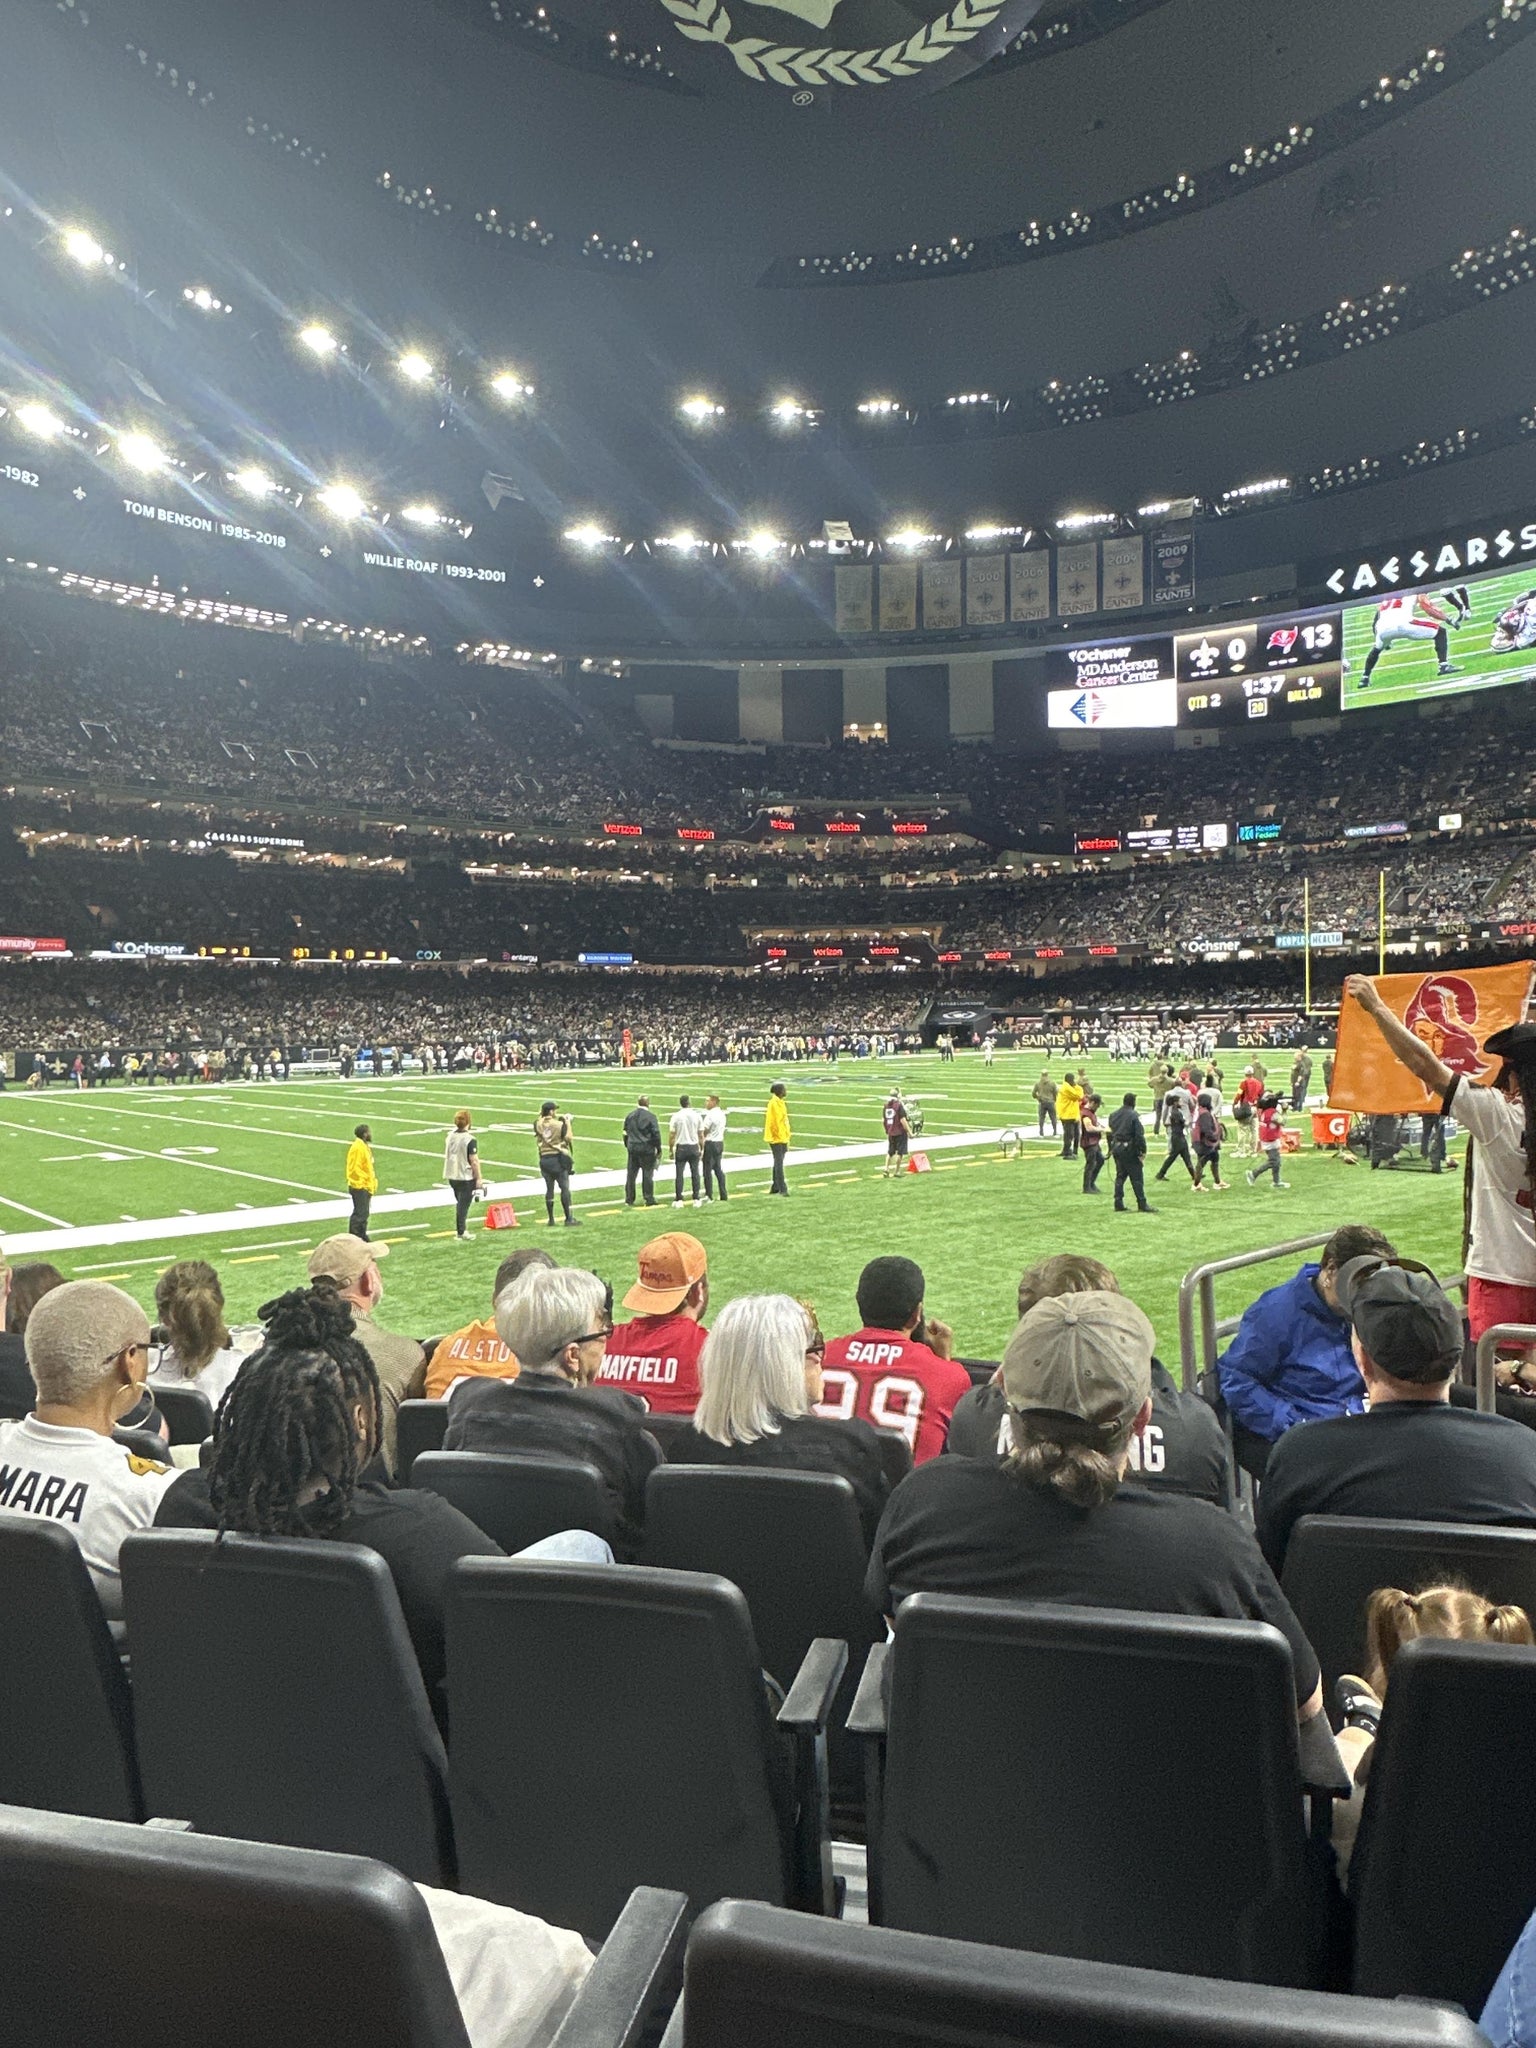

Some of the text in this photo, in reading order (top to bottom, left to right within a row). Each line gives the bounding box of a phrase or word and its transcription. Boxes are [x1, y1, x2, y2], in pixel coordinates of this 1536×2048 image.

[123, 499, 287, 548] TOM BENSON 1985-2018
[1158, 544, 1188, 558] 2009
[363, 552, 506, 582] WILLIE ROAF 1993-2001
[1326, 529, 1515, 594] CAESARS
[1154, 588, 1191, 601] SAINTS
[1301, 623, 1333, 649] 13
[1077, 647, 1131, 662] Ochsner
[1227, 638, 1246, 660] 0
[1100, 659, 1158, 675] Anderson
[1076, 670, 1159, 688] Cancer Center
[1242, 674, 1286, 697] 1:37
[1210, 693, 1221, 707] 2
[604, 823, 643, 836] verizon
[677, 828, 715, 840] verizon
[826, 822, 861, 833] verizon
[892, 822, 928, 833] verizon
[1344, 826, 1377, 837] VENTURE
[204, 832, 305, 847] CAESARS SUPERDOME
[1078, 838, 1119, 850] verizon
[1360, 930, 1393, 939] SAINS
[1436, 924, 1472, 935] SAINTS
[1188, 939, 1240, 953] Ochsner
[1277, 933, 1342, 947] PEOPLE HEALTH
[124, 942, 184, 955] Ochsner
[416, 950, 442, 960] COX
[813, 948, 843, 957] verizon
[869, 946, 900, 955] verizon
[1035, 949, 1064, 958] verizon
[511, 953, 538, 963] entergy
[1022, 1034, 1066, 1046] SAINTS
[1237, 1033, 1289, 1046] SANTS
[1329, 1117, 1345, 1136] G
[640, 1262, 673, 1284] Tampa
[845, 1341, 904, 1366] SAPP
[598, 1354, 679, 1383] MAYFIELD
